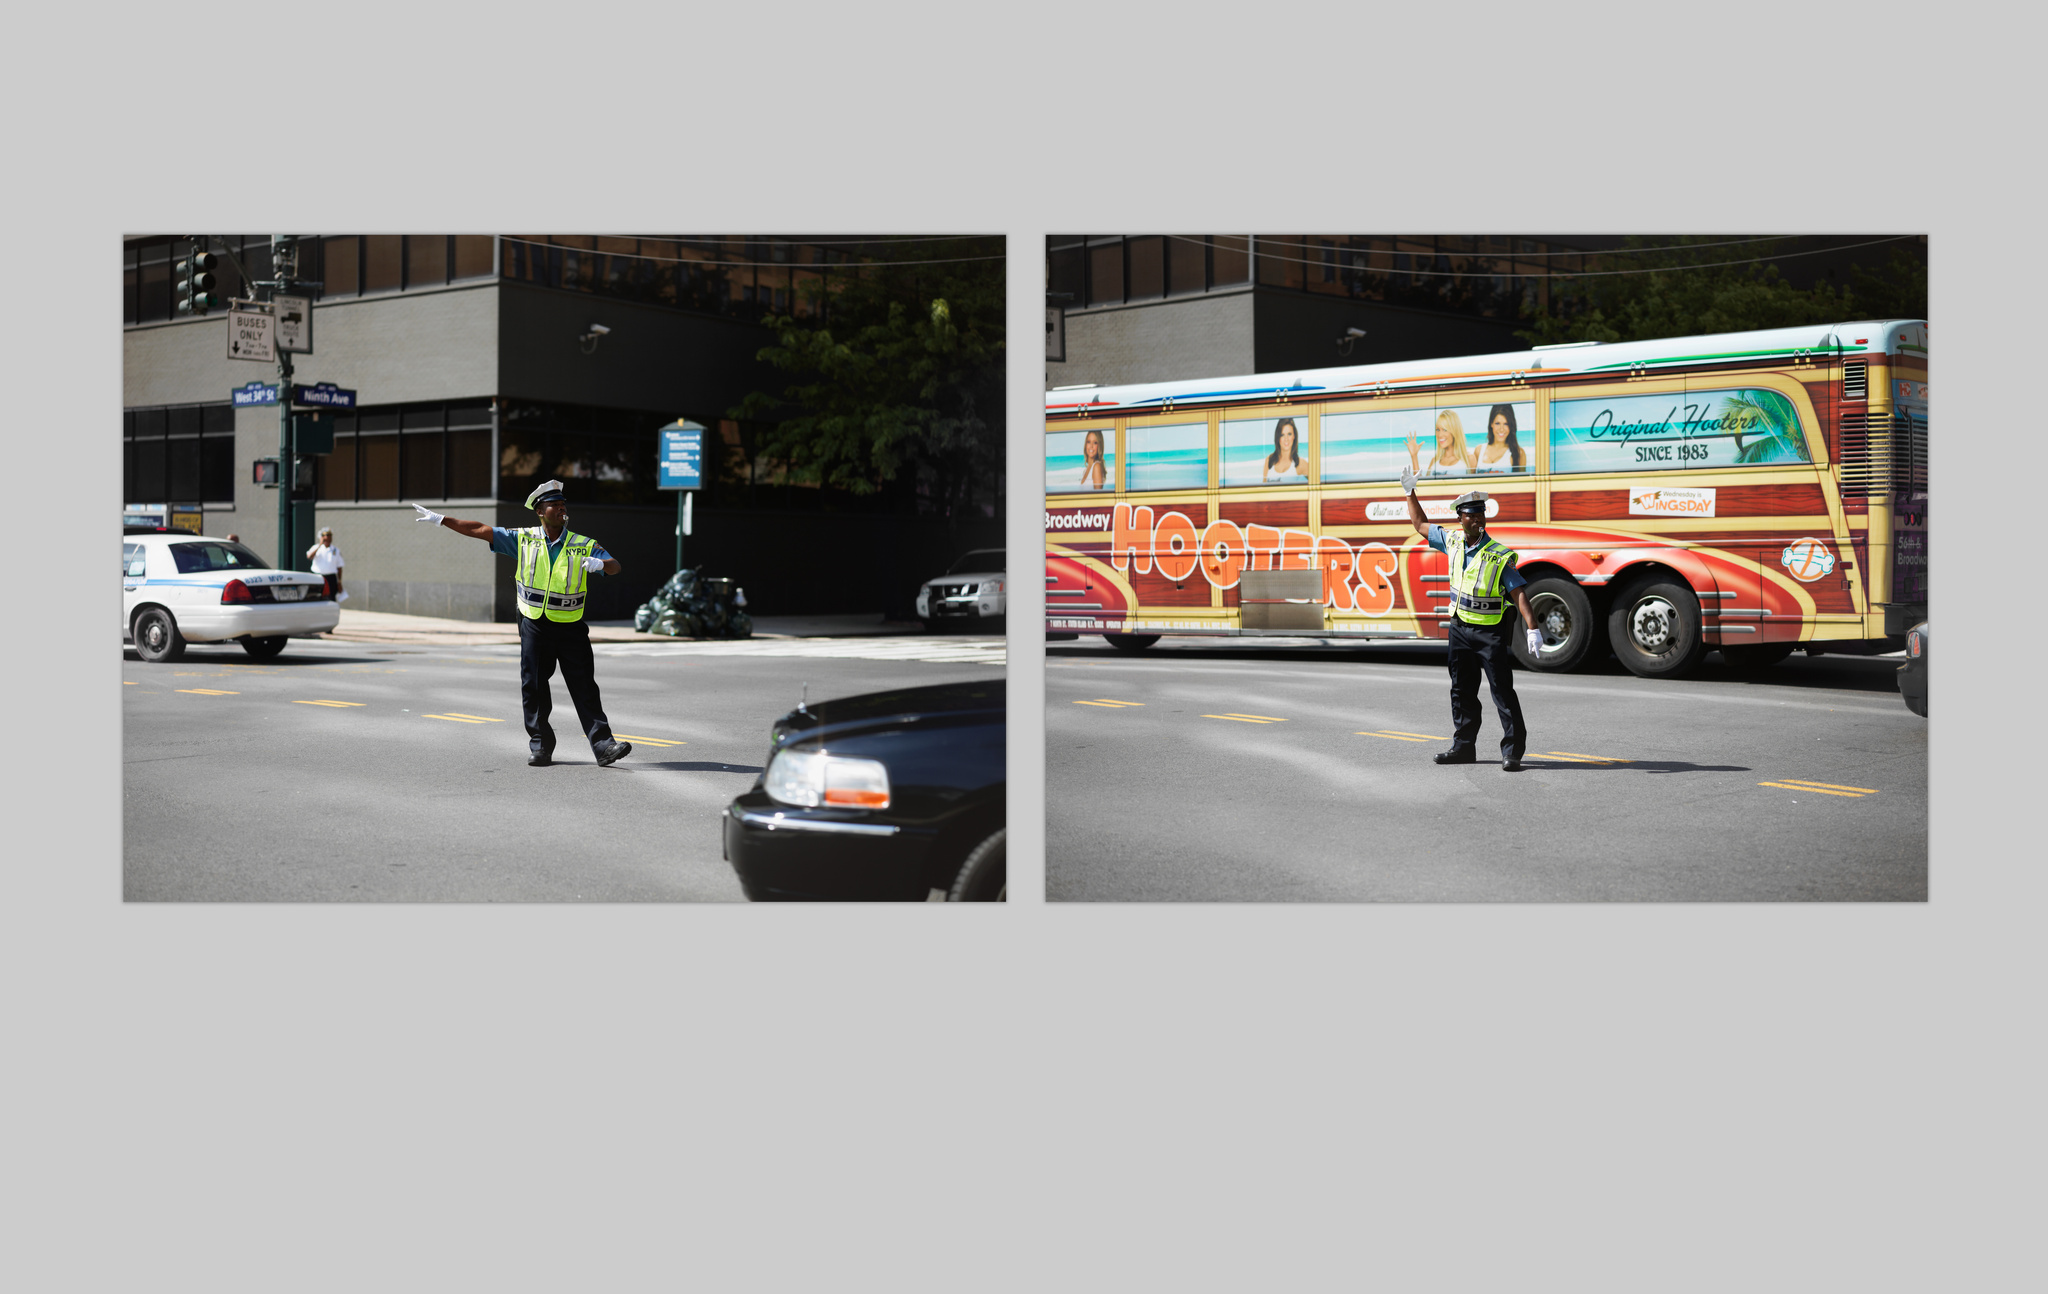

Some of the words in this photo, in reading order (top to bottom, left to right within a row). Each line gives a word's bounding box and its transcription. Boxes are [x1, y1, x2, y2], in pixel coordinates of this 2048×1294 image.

[237, 316, 267, 329] BUSES
[240, 329, 263, 341] ONLY
[235, 391, 252, 404] West
[266, 388, 275, 401] St
[304, 389, 330, 403] Ninth
[331, 393, 350, 405] Ave
[1590, 406, 1677, 448] Original
[1682, 403, 1758, 435] Hooters
[1635, 445, 1672, 462] SINCE
[1677, 444, 1709, 461] 1983
[1663, 491, 1696, 499] Wednesday
[566, 548, 587, 556] NYPD
[1481, 552, 1502, 565] NYPD
[1112, 502, 1398, 618] HOOTERS
[561, 598, 578, 607] PD
[1471, 601, 1490, 609] PD
